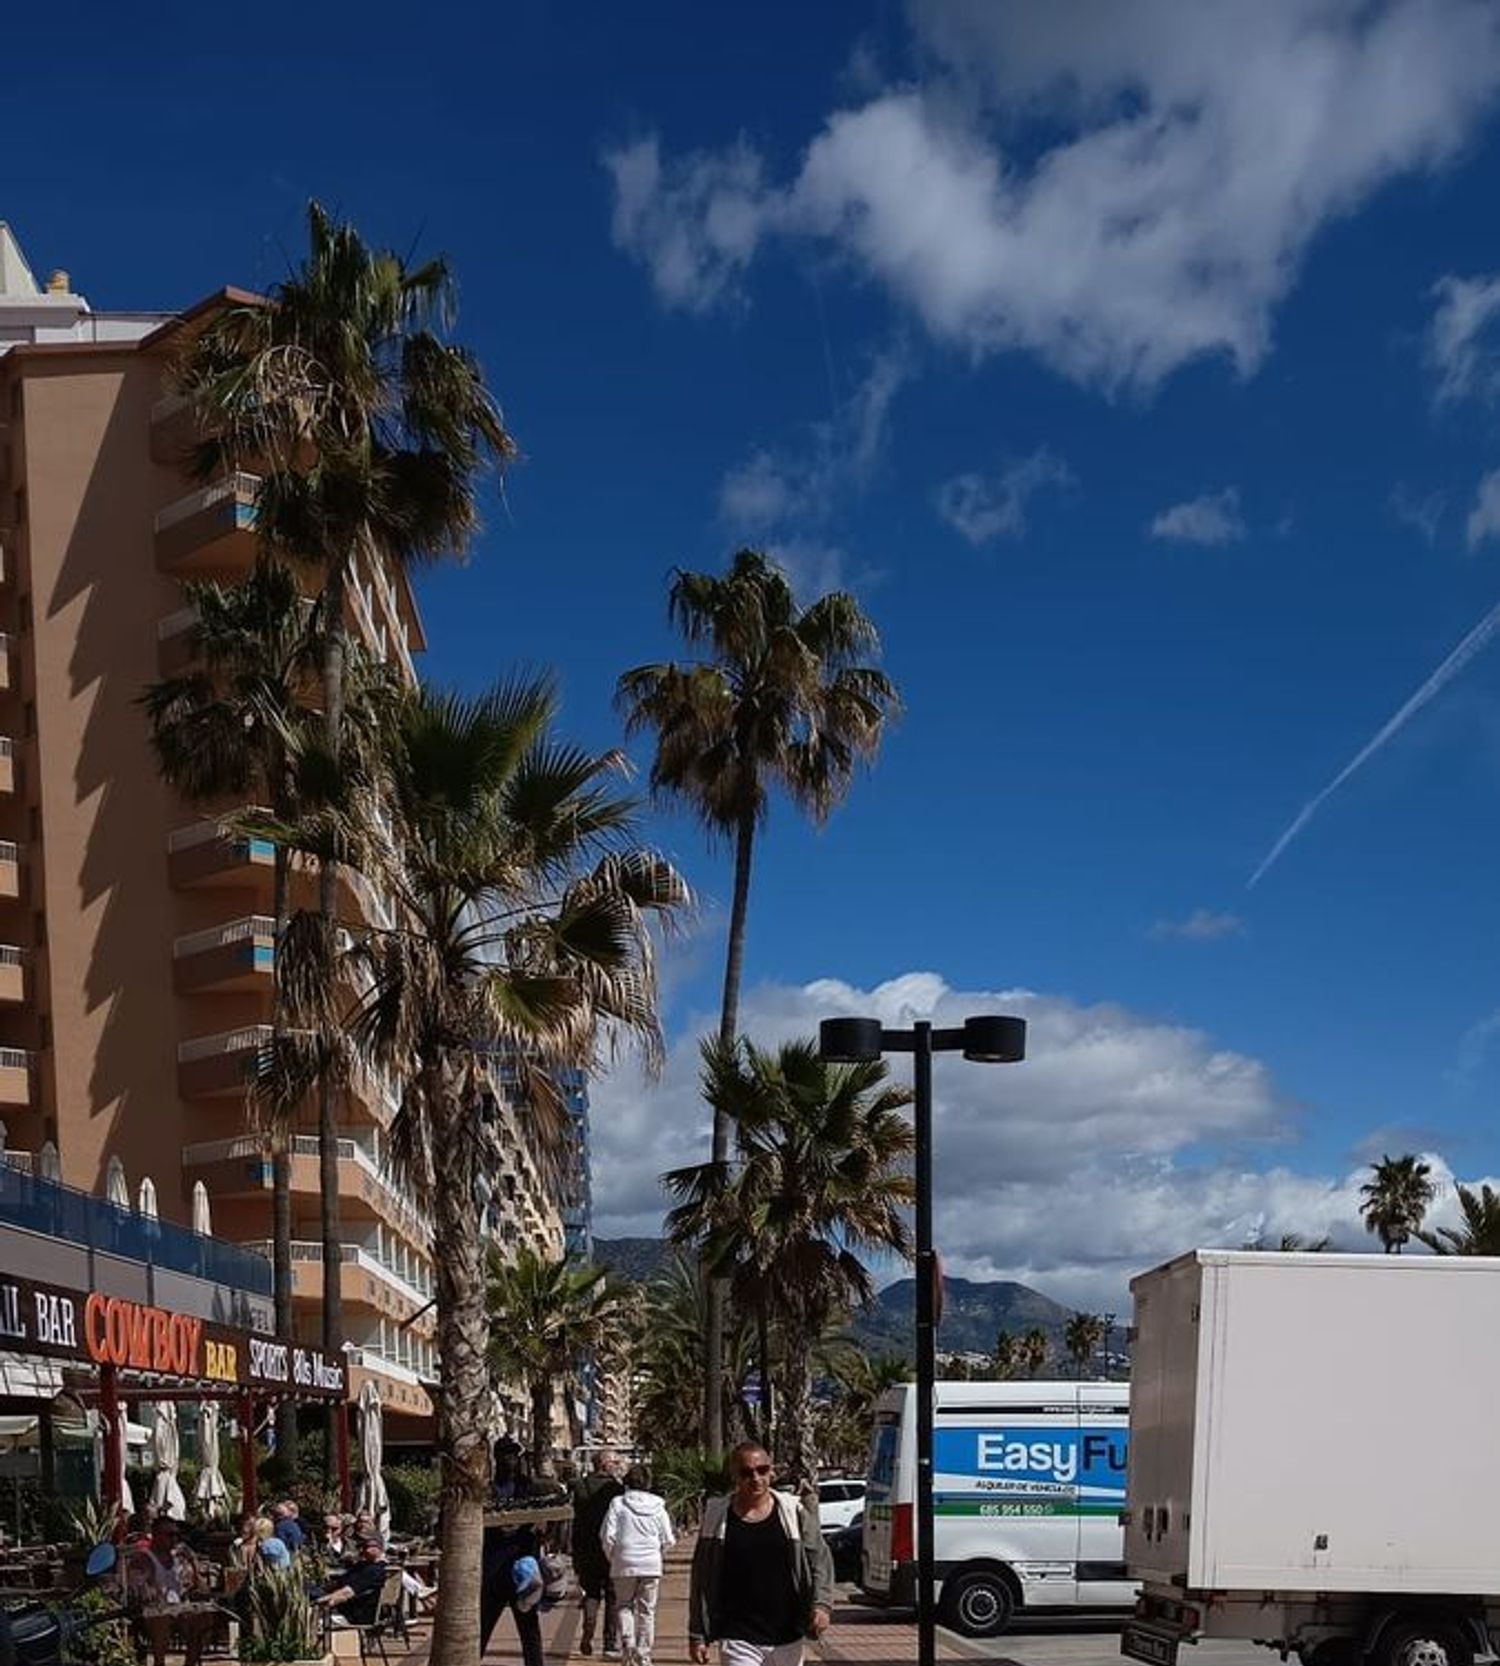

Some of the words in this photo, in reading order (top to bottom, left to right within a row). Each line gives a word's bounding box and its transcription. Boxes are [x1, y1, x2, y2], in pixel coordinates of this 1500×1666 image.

[34, 1291, 77, 1348] BAR
[85, 1292, 202, 1376] COWBOY
[205, 1340, 237, 1382] BAR
[249, 1338, 288, 1383] SPORTS
[311, 1351, 343, 1390] Music
